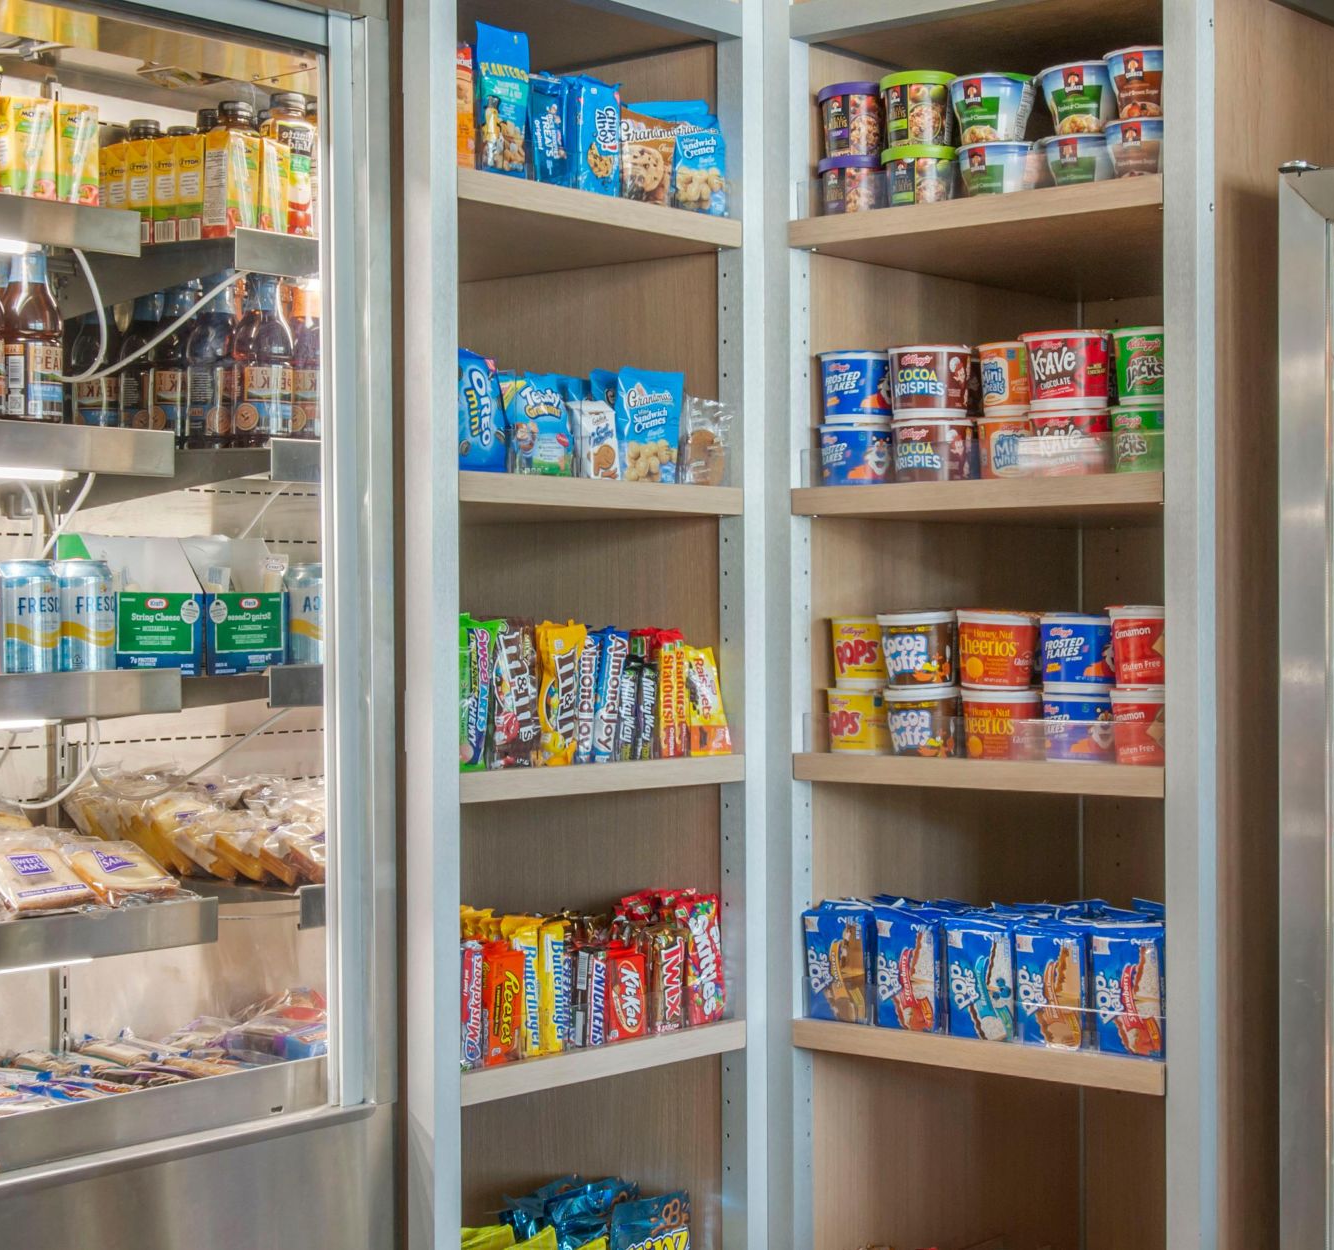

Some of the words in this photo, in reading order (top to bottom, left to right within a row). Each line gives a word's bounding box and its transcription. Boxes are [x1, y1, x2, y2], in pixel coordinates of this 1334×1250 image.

[603, 106, 617, 144] Chips
[684, 146, 715, 159] Cremes
[1130, 356, 1158, 367] APPLE
[825, 371, 861, 386] FROSTED
[897, 369, 938, 382] COCOA
[1040, 377, 1071, 389] CHOCOLATE
[520, 386, 561, 408] Teddy
[826, 381, 857, 395] FLAKES
[894, 381, 945, 397] KRISPIES
[465, 388, 480, 437] mini
[469, 368, 491, 446] OREO
[633, 408, 668, 425] Sandwich
[635, 416, 666, 434] Cremes
[896, 442, 934, 455] COCOA
[894, 454, 942, 470] KRISPIES
[16, 596, 61, 616] FRESC
[75, 594, 115, 615] FRESC
[131, 613, 154, 623] String
[155, 613, 181, 622] Cheese
[973, 628, 995, 640] Honey
[996, 630, 1013, 639] Nut
[1115, 626, 1151, 639] Cinnamon
[882, 634, 926, 653] Cocoa
[959, 635, 1017, 658] Cheerios
[1044, 636, 1085, 652] FROSTED
[1046, 647, 1080, 662] FLAKES
[605, 633, 627, 713] Almond
[1122, 661, 1145, 672] Gluten
[1146, 659, 1161, 669] Free
[13, 856, 41, 865] SWEET
[689, 914, 717, 1016] Skittles
[661, 936, 685, 1019] TWIX
[900, 955, 913, 1001] Strawberry
[467, 952, 483, 1040] Musketeers
[525, 944, 539, 1048] Butterfinger
[549, 940, 565, 1040] Butterfinger
[501, 970, 519, 1046] Reese's
[590, 960, 606, 1046] SNICKERS
